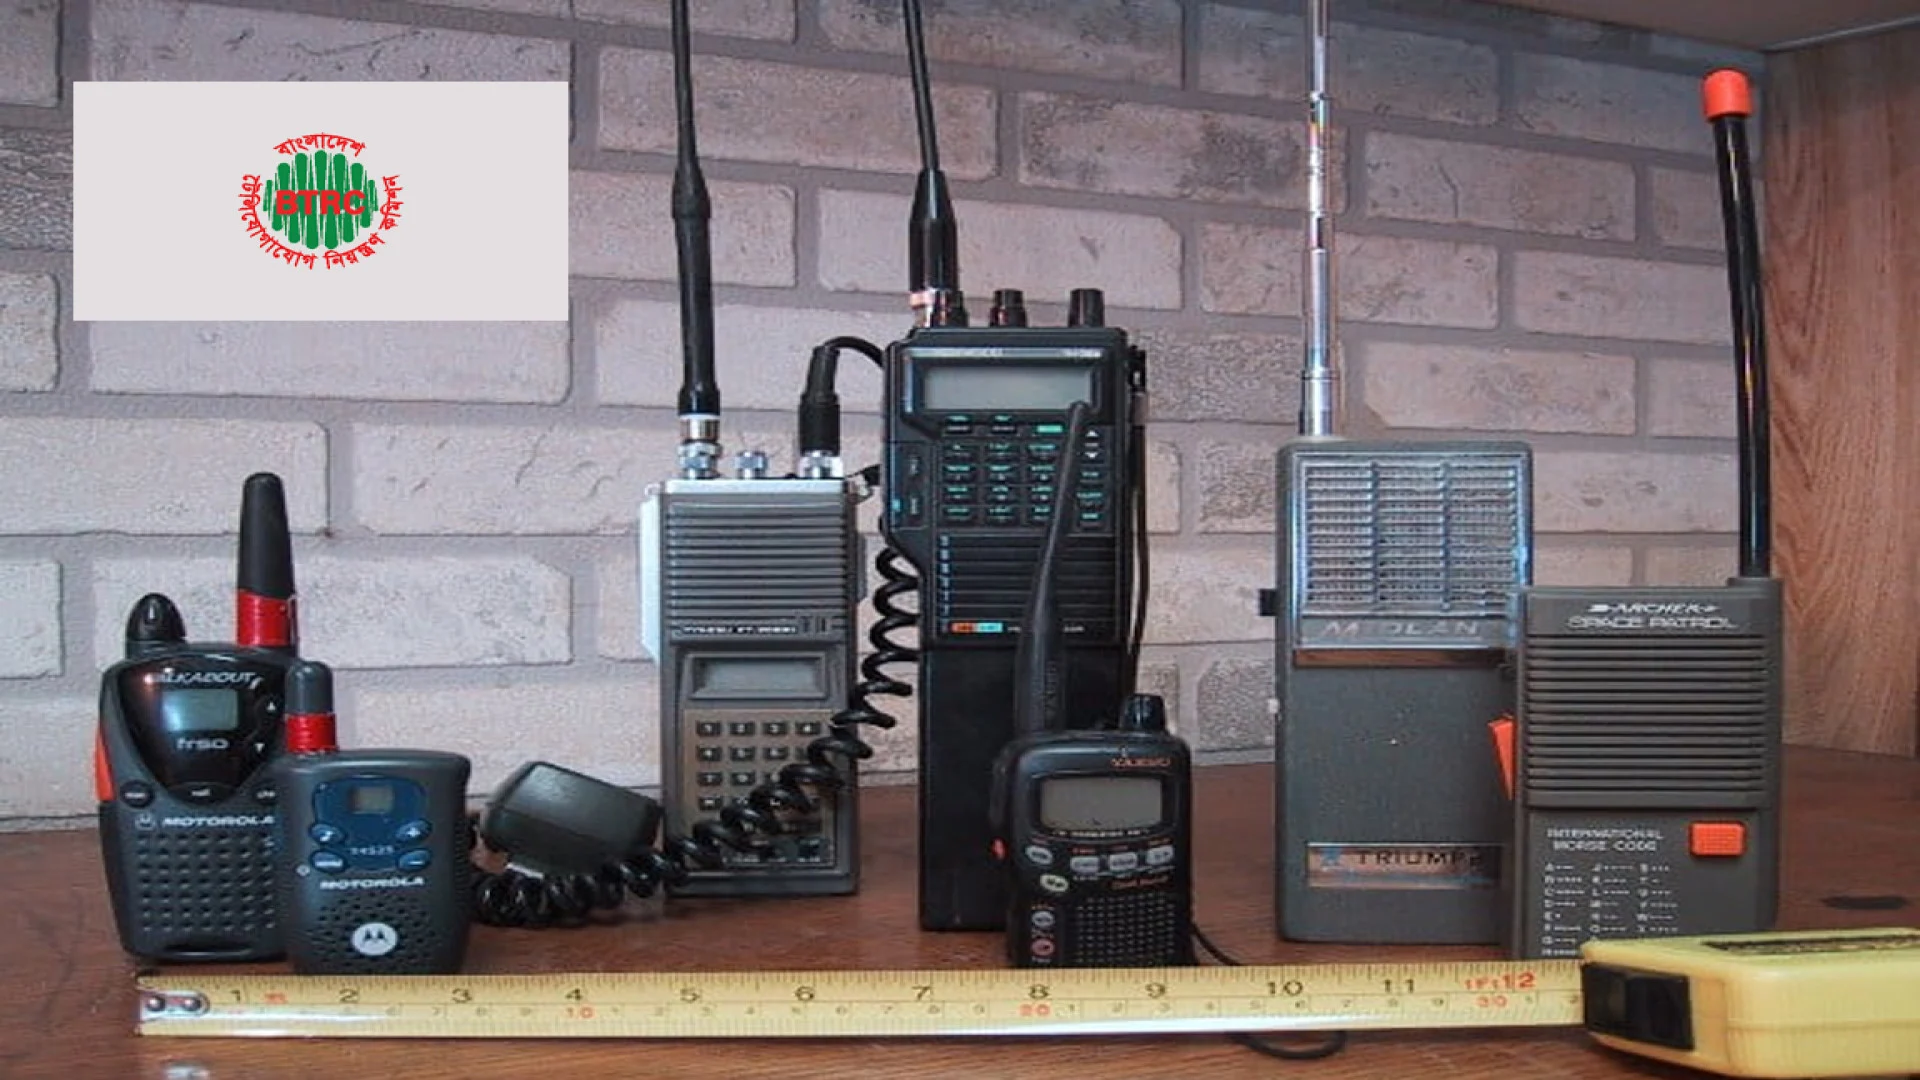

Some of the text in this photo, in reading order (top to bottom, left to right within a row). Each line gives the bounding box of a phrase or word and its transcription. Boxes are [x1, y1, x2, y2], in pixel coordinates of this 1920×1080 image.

[161, 815, 275, 827] MOTOROLA
[319, 876, 424, 890] MOTOROLA
[338, 988, 359, 1003] 2
[451, 988, 473, 1003] 3
[565, 988, 583, 1002] 4
[679, 987, 700, 1002] 5
[795, 986, 814, 1001] 6
[911, 985, 931, 1001] 7
[1028, 983, 1049, 1000] 8
[1145, 982, 1166, 998] 9
[1266, 980, 1303, 996] 10
[1384, 978, 1416, 994] 11
